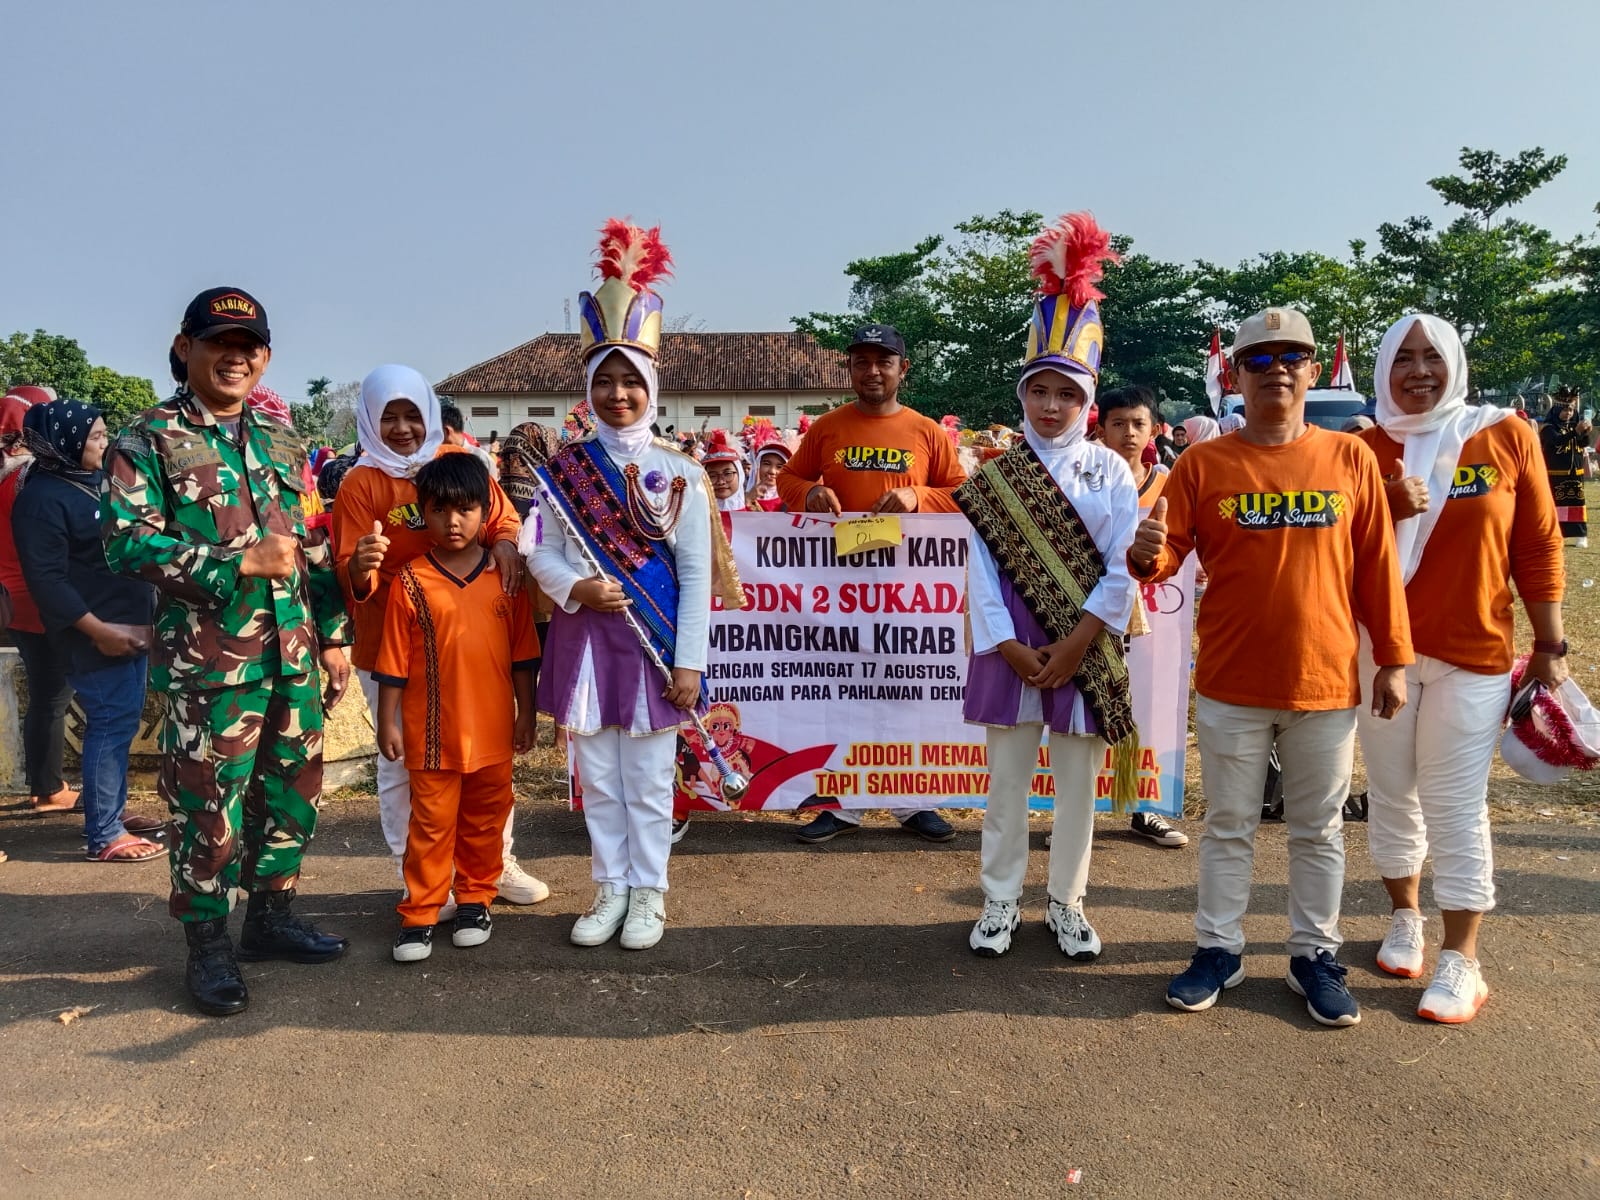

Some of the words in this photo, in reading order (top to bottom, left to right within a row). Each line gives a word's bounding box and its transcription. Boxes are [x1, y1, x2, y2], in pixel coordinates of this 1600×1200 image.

[847, 447, 901, 463] UPTD
[1240, 491, 1326, 515] UPTD
[1238, 510, 1269, 525] Sdn
[1271, 511, 1281, 525] 2
[740, 583, 804, 613] SDN
[812, 585, 830, 613] 2
[771, 662, 855, 678] SEMANGAT
[861, 662, 876, 678] 17
[883, 664, 961, 682] AGUSTUS,
[791, 685, 831, 701] PARA
[838, 685, 923, 701] PAHLAWAN
[846, 745, 912, 767] JODOH
[815, 773, 860, 796] TAPI
